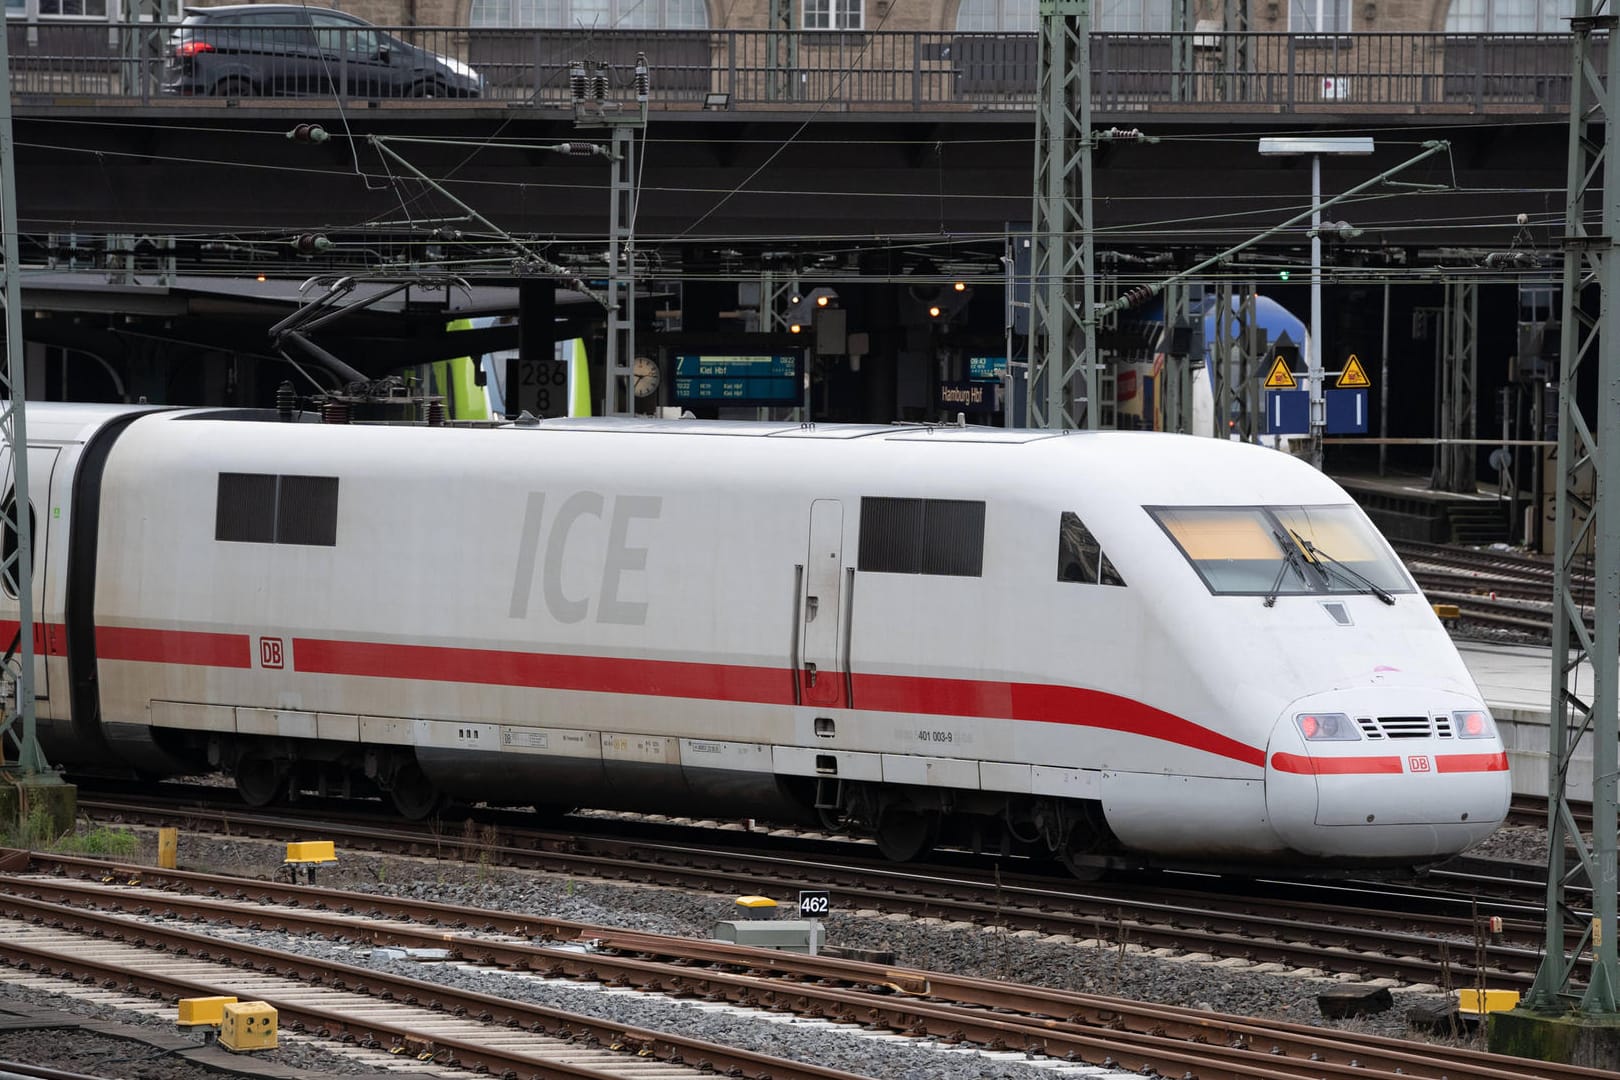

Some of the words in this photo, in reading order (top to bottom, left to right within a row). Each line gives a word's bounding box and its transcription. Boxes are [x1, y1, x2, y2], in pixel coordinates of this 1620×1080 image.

[676, 356, 684, 371] 7
[521, 363, 565, 386] 286
[537, 389, 549, 409] 8
[941, 385, 970, 406] Hamburg
[971, 387, 983, 403] Hbf
[508, 490, 663, 625] ICE
[261, 640, 282, 666] DB
[918, 730, 931, 742] 401
[932, 731, 953, 743] 003-9
[1410, 757, 1429, 771] DB
[801, 898, 827, 912] 462
